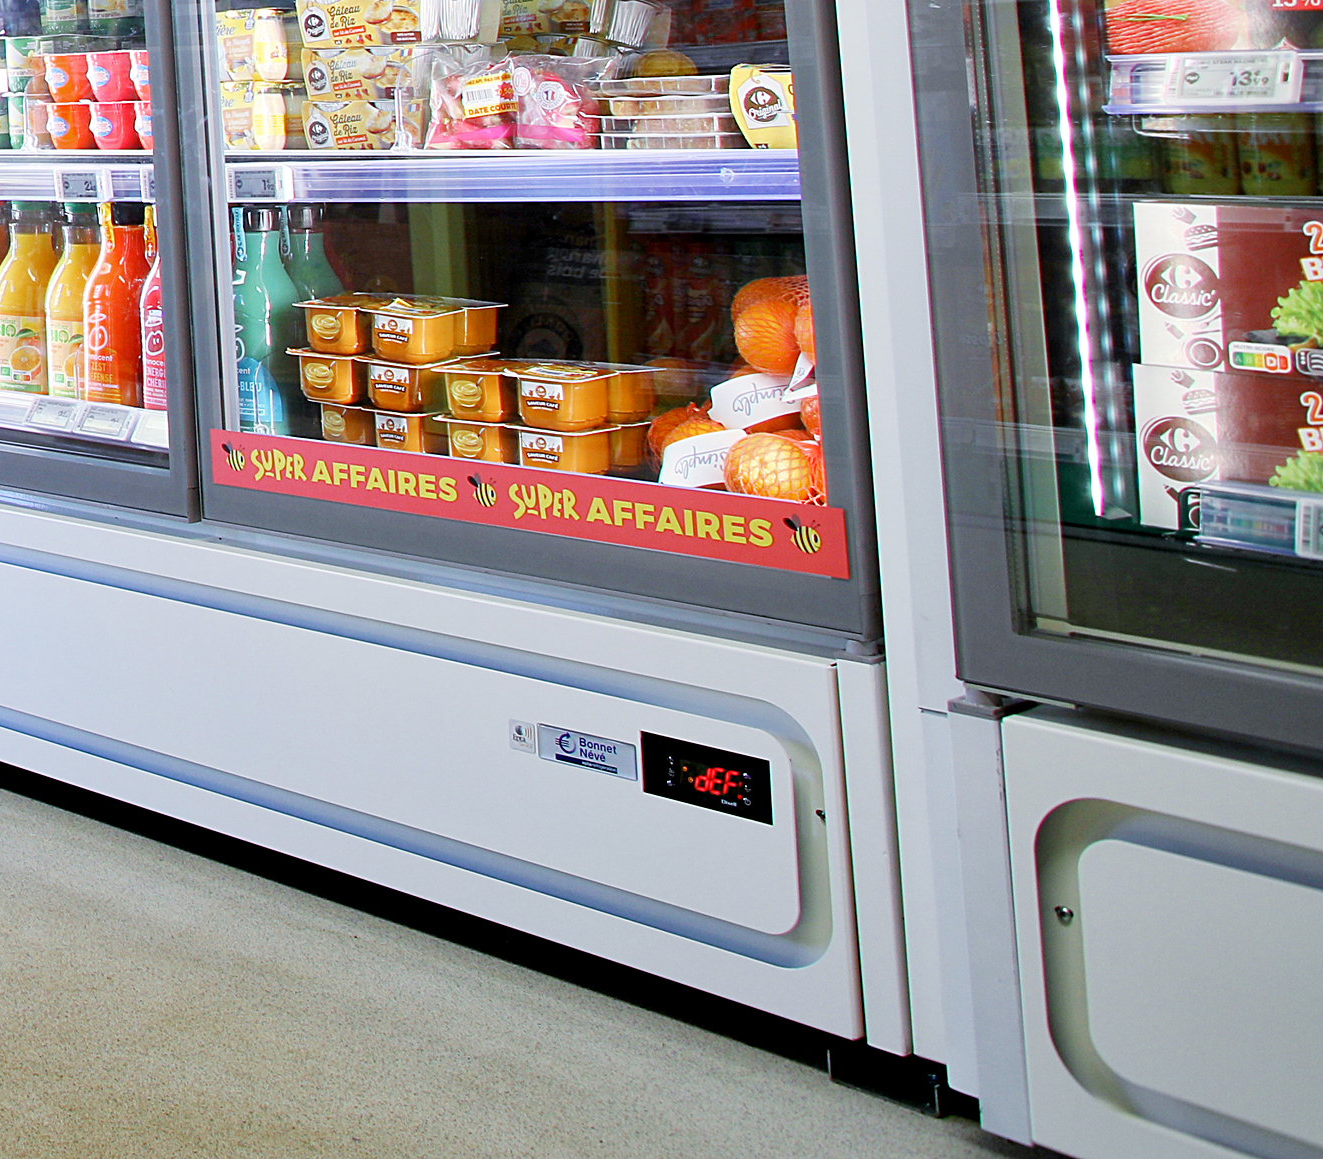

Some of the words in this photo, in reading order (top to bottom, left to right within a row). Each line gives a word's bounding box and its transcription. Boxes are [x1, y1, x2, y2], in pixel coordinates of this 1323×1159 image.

[327, 5, 361, 19] Gâteau
[330, 20, 340, 28] de
[342, 17, 356, 27] Riz
[328, 58, 357, 72] Gâteau
[340, 71, 354, 81] Riz
[468, 106, 489, 116] DATE
[748, 100, 782, 119] Original
[329, 113, 362, 127] Gâteau
[333, 128, 342, 137] de
[343, 125, 358, 136] Riz
[526, 400, 545, 408] SAVEUR
[546, 402, 559, 410] CAFÉ
[526, 452, 545, 460] SAVEUR
[546, 454, 559, 462] CAFÉ
[250, 447, 308, 483] SUPER
[310, 459, 459, 503] AFFAIRES
[508, 483, 580, 521] SUPER
[586, 497, 774, 548] AFFAIRES
[578, 736, 617, 756] Bonnet
[579, 748, 606, 762] Névé
